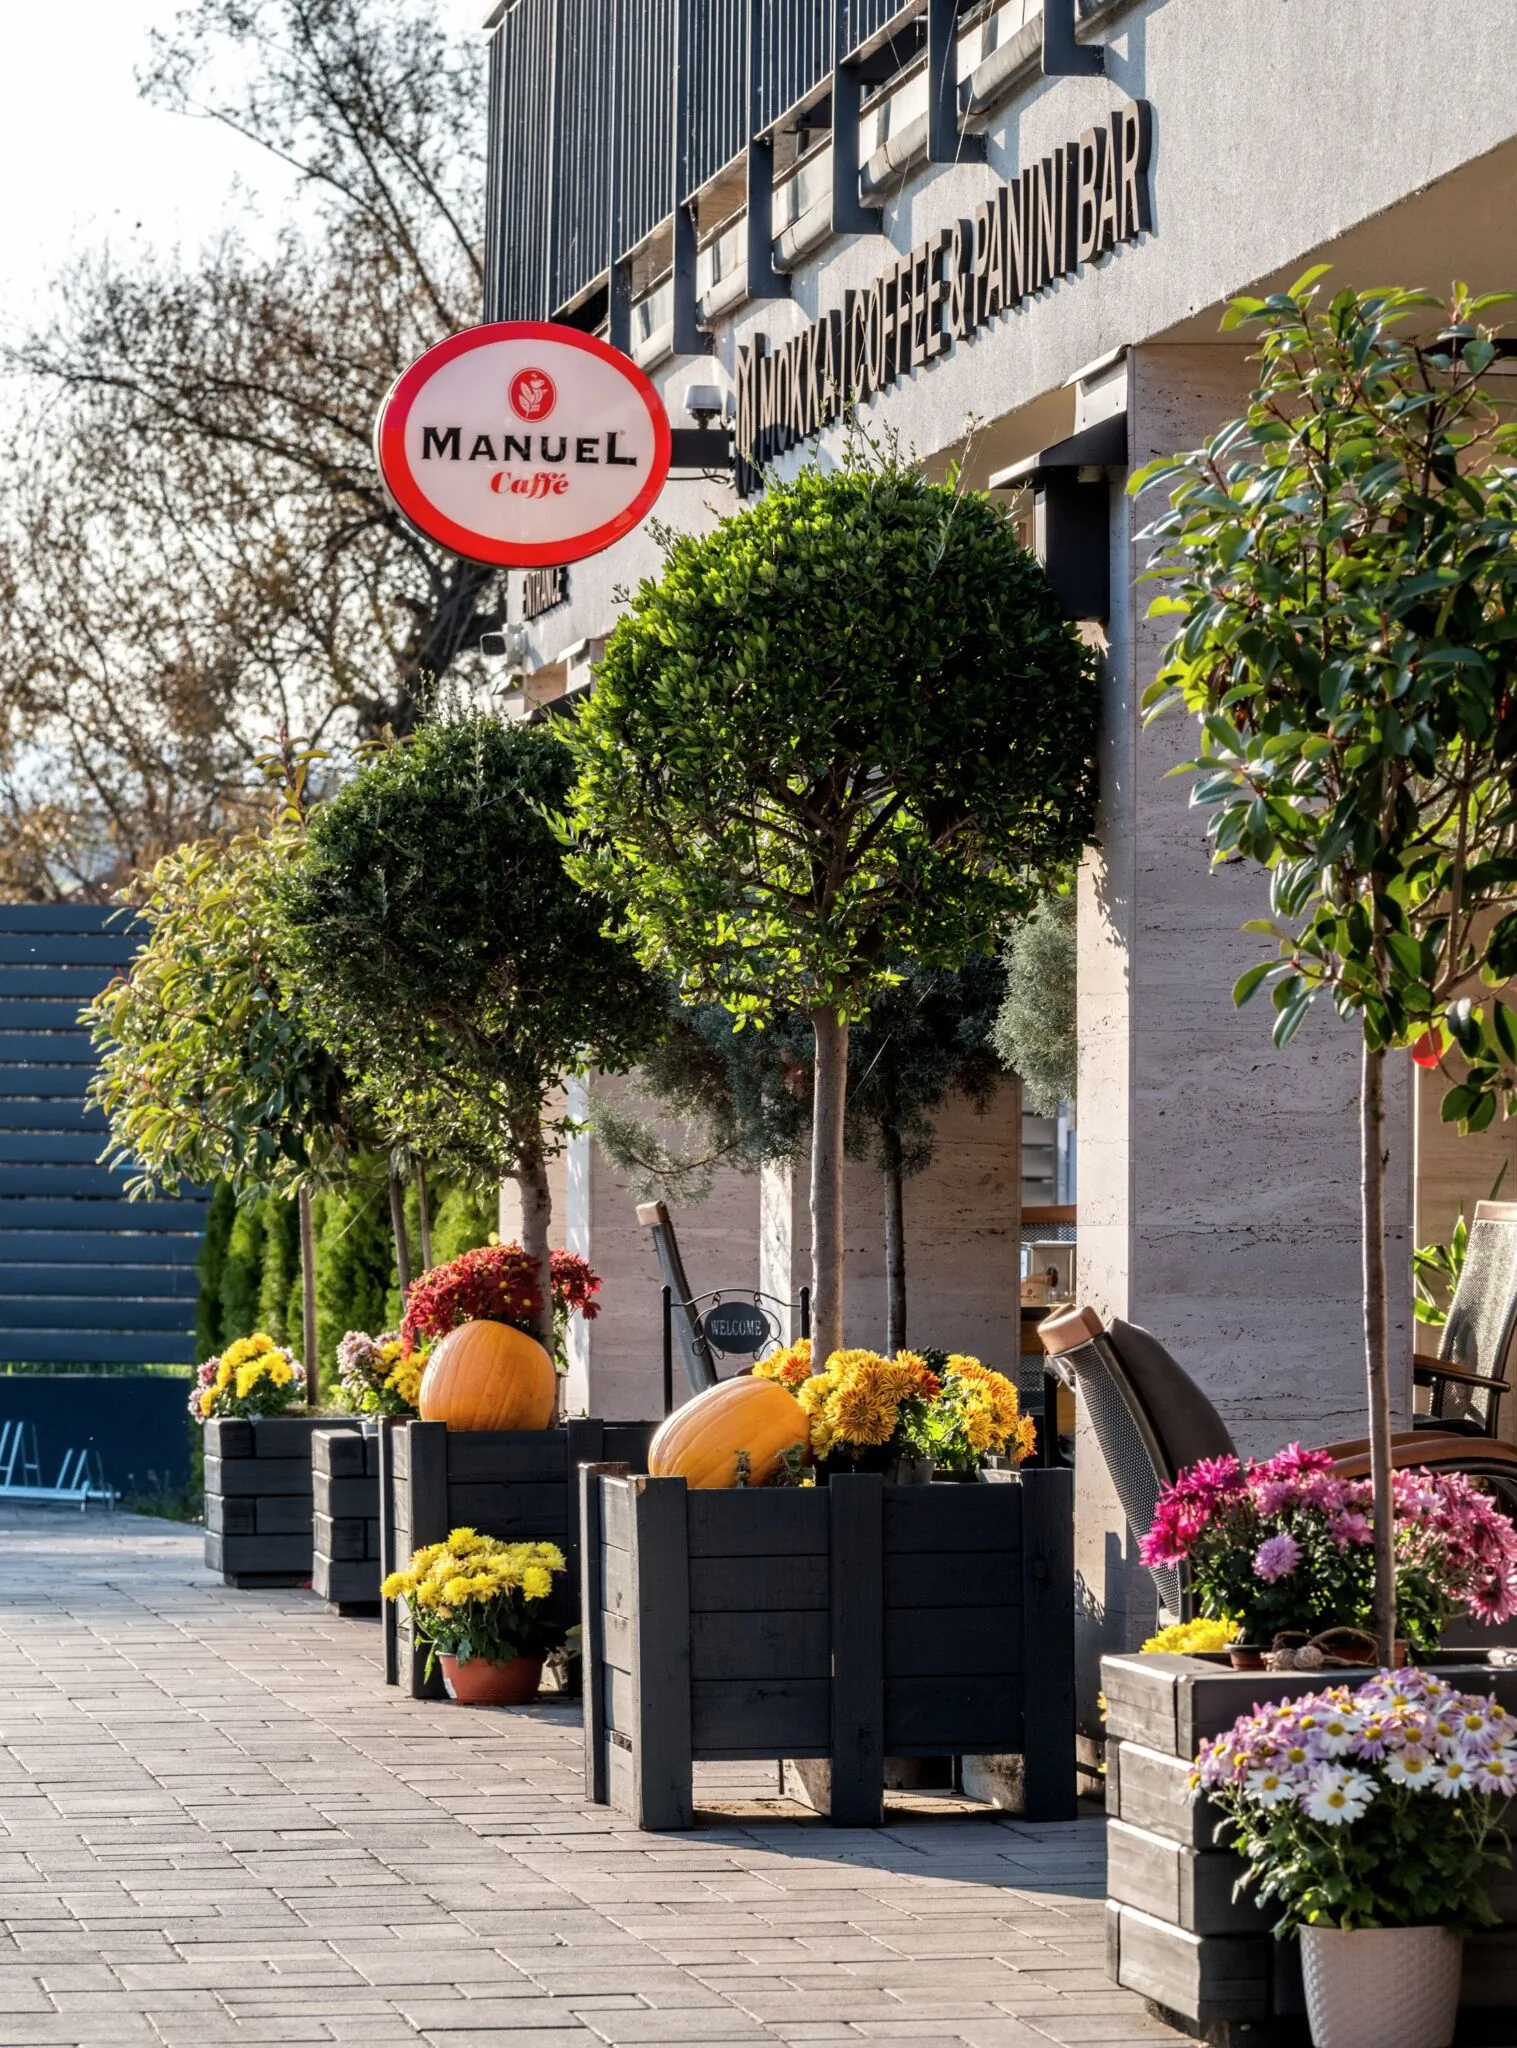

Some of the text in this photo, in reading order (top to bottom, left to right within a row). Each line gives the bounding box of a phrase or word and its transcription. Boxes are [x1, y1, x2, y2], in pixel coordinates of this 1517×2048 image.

[760, 309, 838, 463] MOKKA
[851, 229, 948, 403] COFFEE
[949, 219, 973, 341] &
[972, 142, 1077, 327] PANINI
[1077, 99, 1149, 263] BAR
[421, 426, 637, 467] MANUEL
[711, 1319, 762, 1337] WELCOME
